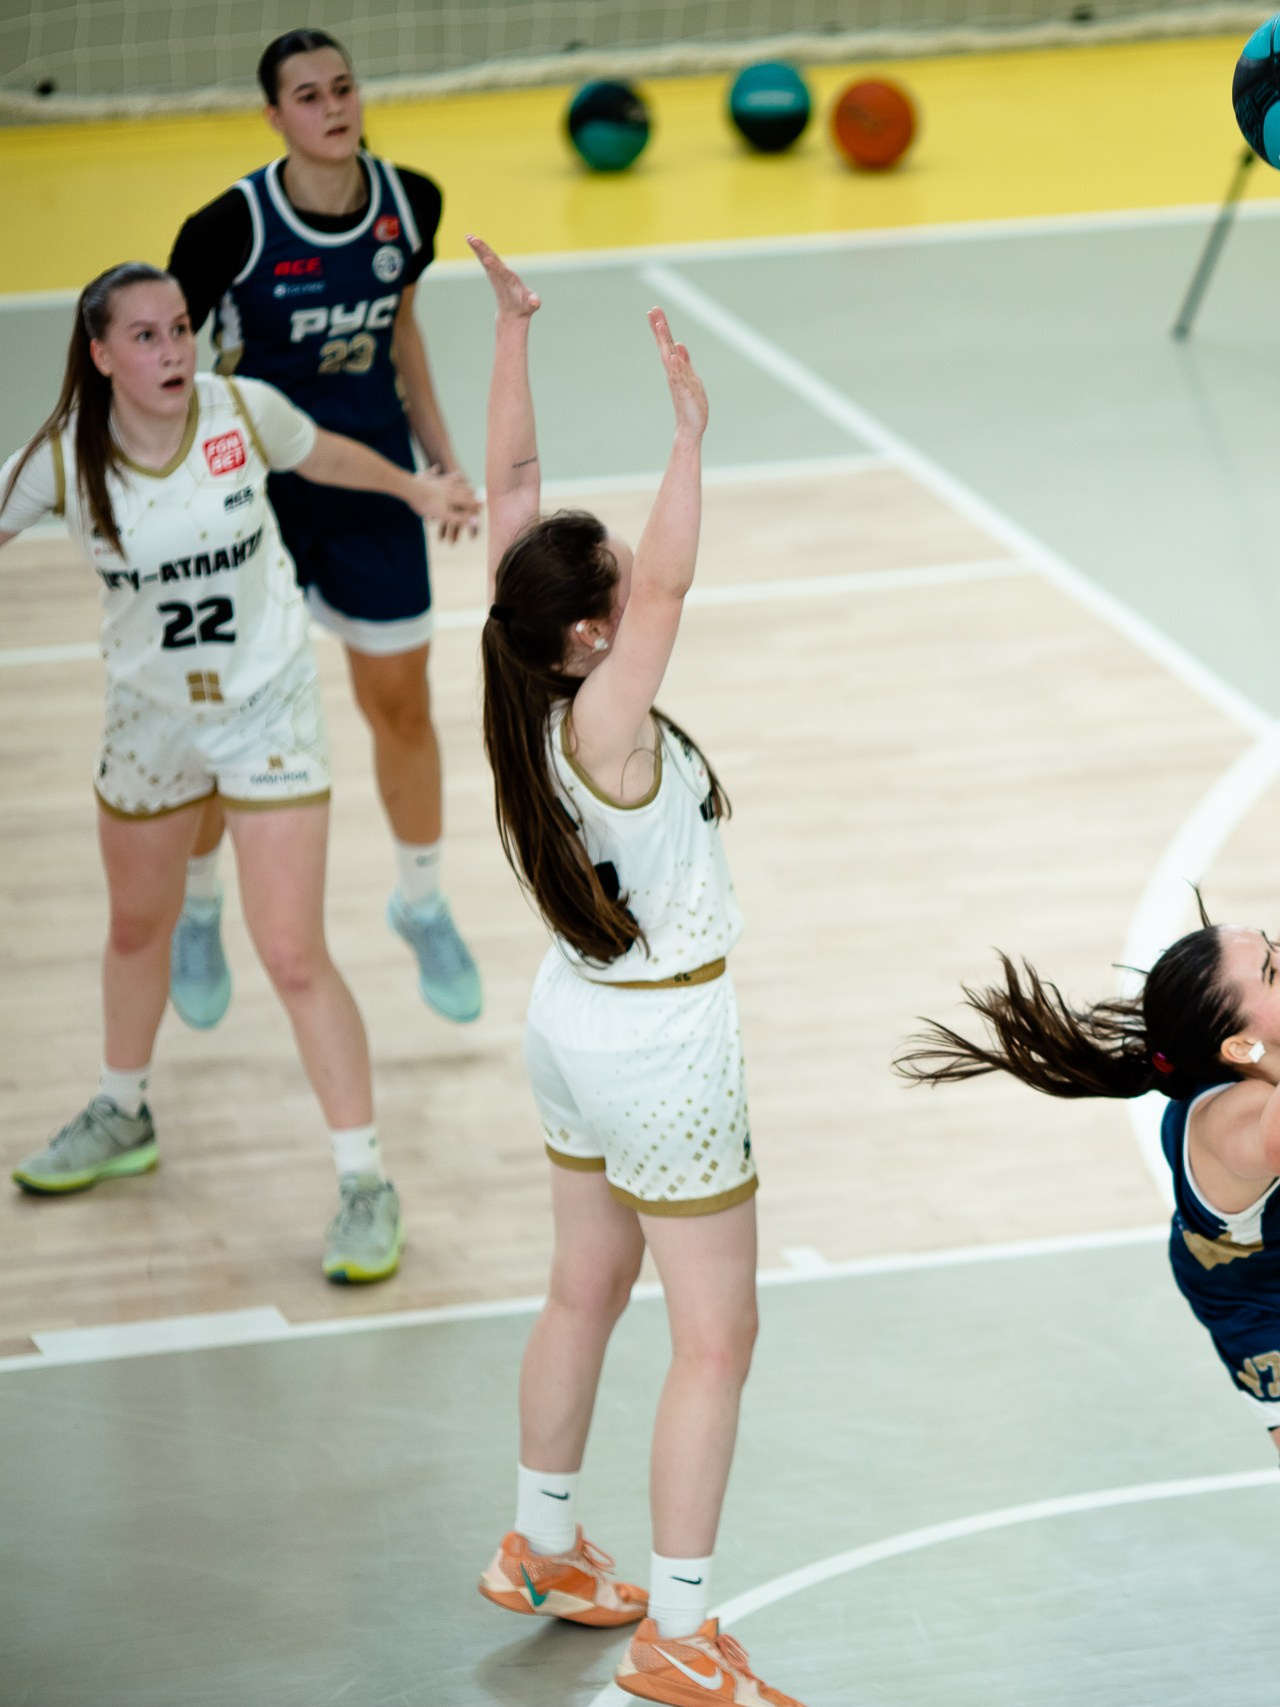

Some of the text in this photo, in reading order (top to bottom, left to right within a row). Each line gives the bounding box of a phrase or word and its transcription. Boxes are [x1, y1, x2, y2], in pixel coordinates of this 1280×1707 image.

[290, 295, 400, 343] РУС
[318, 333, 376, 375] 23
[158, 596, 236, 650] 22
